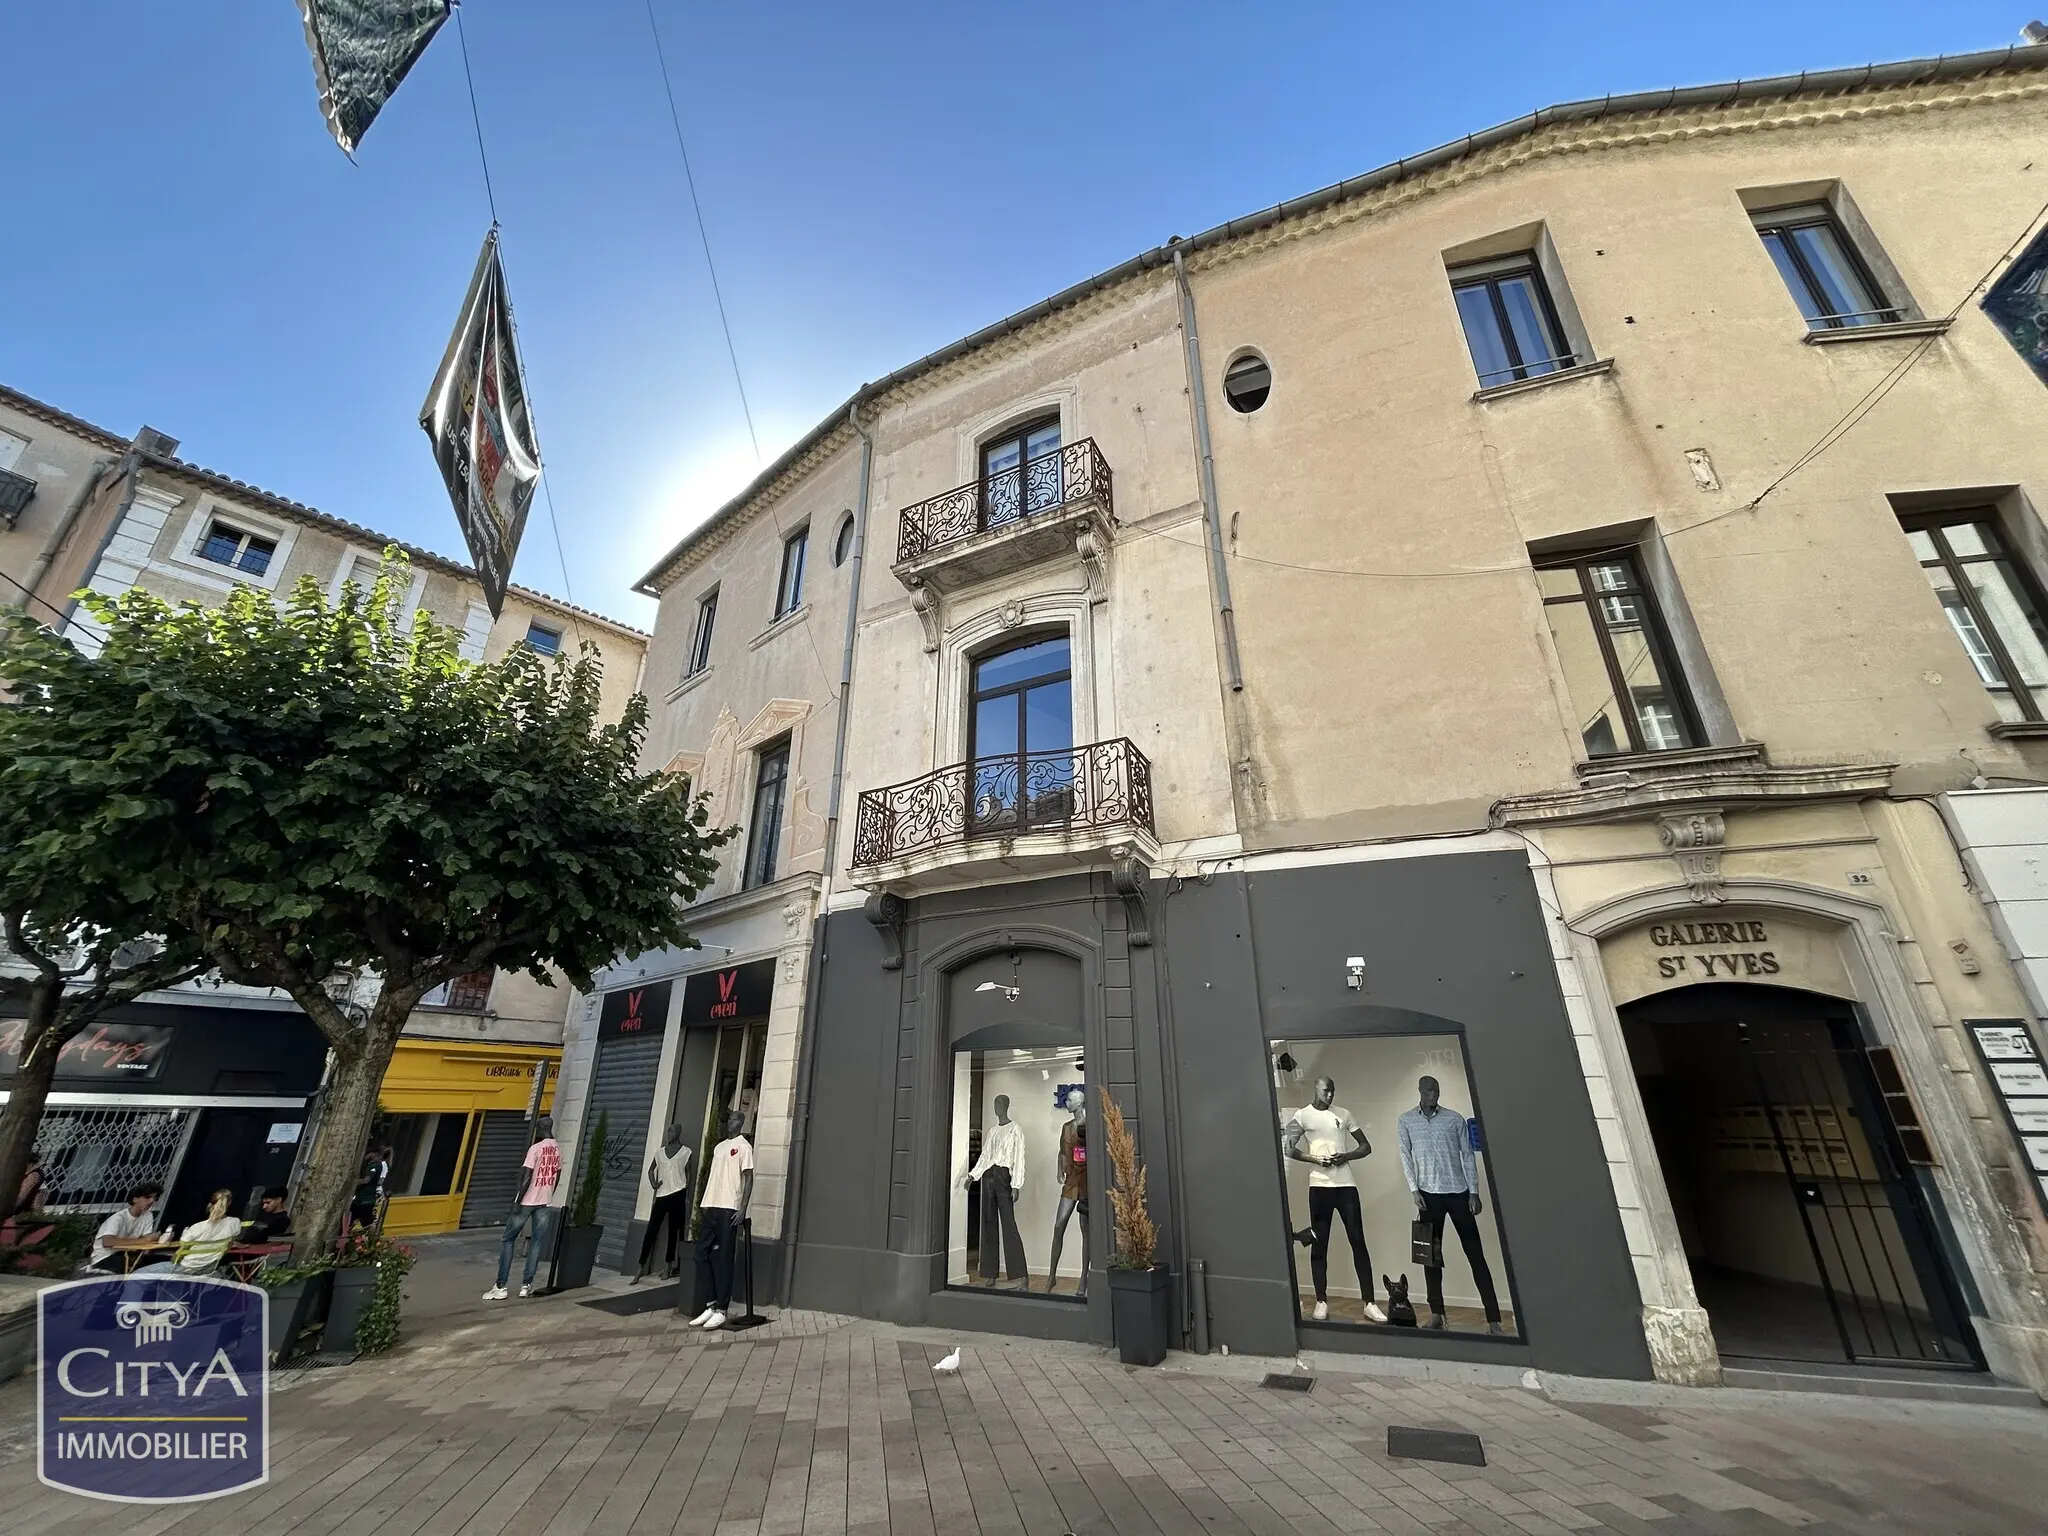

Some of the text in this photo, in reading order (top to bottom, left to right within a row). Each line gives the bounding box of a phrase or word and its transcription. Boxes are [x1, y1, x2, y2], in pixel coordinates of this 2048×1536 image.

[1688, 856, 1716, 874] 16
[1851, 874, 1869, 883] 32
[1650, 920, 1768, 947] GALERIE
[1693, 951, 1781, 977] YVES
